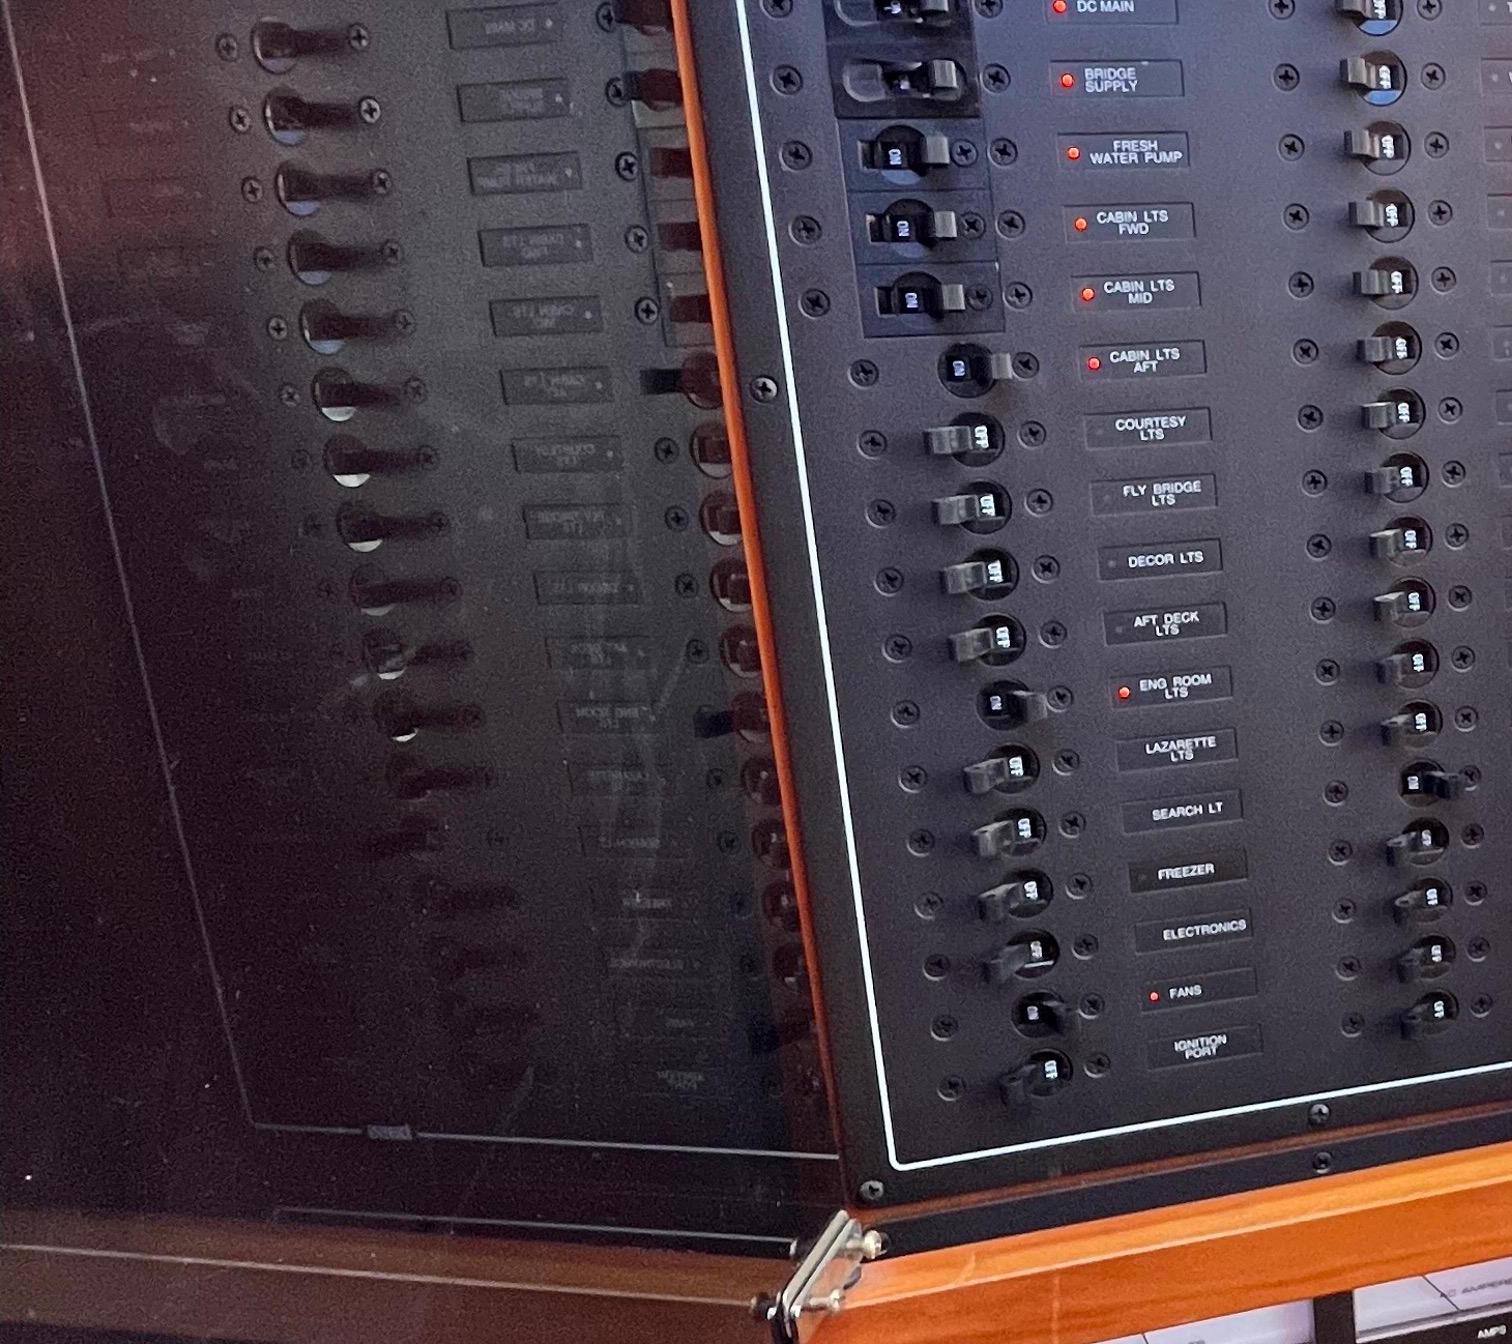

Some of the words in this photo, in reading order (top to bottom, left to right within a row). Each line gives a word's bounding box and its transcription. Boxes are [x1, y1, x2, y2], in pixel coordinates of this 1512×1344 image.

[1076, 0, 1097, 13] DC
[1100, 0, 1135, 13] MAIN
[1084, 67, 1136, 80] BRIDGE
[1085, 80, 1138, 93] SUPPLY
[1113, 139, 1158, 152] FRESH
[1089, 152, 1139, 165] WATER
[1144, 150, 1184, 164] PUMP
[1096, 211, 1137, 224] CABIN
[1143, 210, 1169, 223] LTS
[1118, 223, 1149, 235] FWD
[1103, 280, 1144, 293] CABIN
[1150, 279, 1175, 291] LTS
[1128, 293, 1153, 304] MID
[1109, 350, 1150, 364] CABIN
[1155, 348, 1180, 361] LTS
[1133, 360, 1158, 374] AFT
[1115, 415, 1186, 432] COURTESY
[1139, 428, 1164, 441] LTS
[1122, 484, 1147, 497] FLY
[1153, 480, 1202, 495] BRIDGE
[1151, 494, 1176, 507] LTS
[1128, 553, 1174, 568] DECOR
[1179, 551, 1204, 564] LTS
[1134, 614, 1157, 628] AFT
[1163, 611, 1200, 624] DECK
[1155, 623, 1180, 636] LTS
[1139, 678, 1167, 692] ENG
[1173, 673, 1212, 687] ROOM
[1165, 687, 1188, 700] LTS
[1146, 736, 1217, 754] LAZARETTE
[1170, 749, 1194, 762] LTS
[1152, 804, 1203, 821] SEARCH
[1208, 801, 1223, 814] LT
[1158, 863, 1215, 881] FREEZER
[1163, 919, 1247, 941] ELECTRONICS
[1169, 985, 1202, 999] FANS
[1174, 1034, 1227, 1052] IGNITION
[1185, 1045, 1218, 1060] PORT
[1477, 1324, 1507, 1339] AMPS
